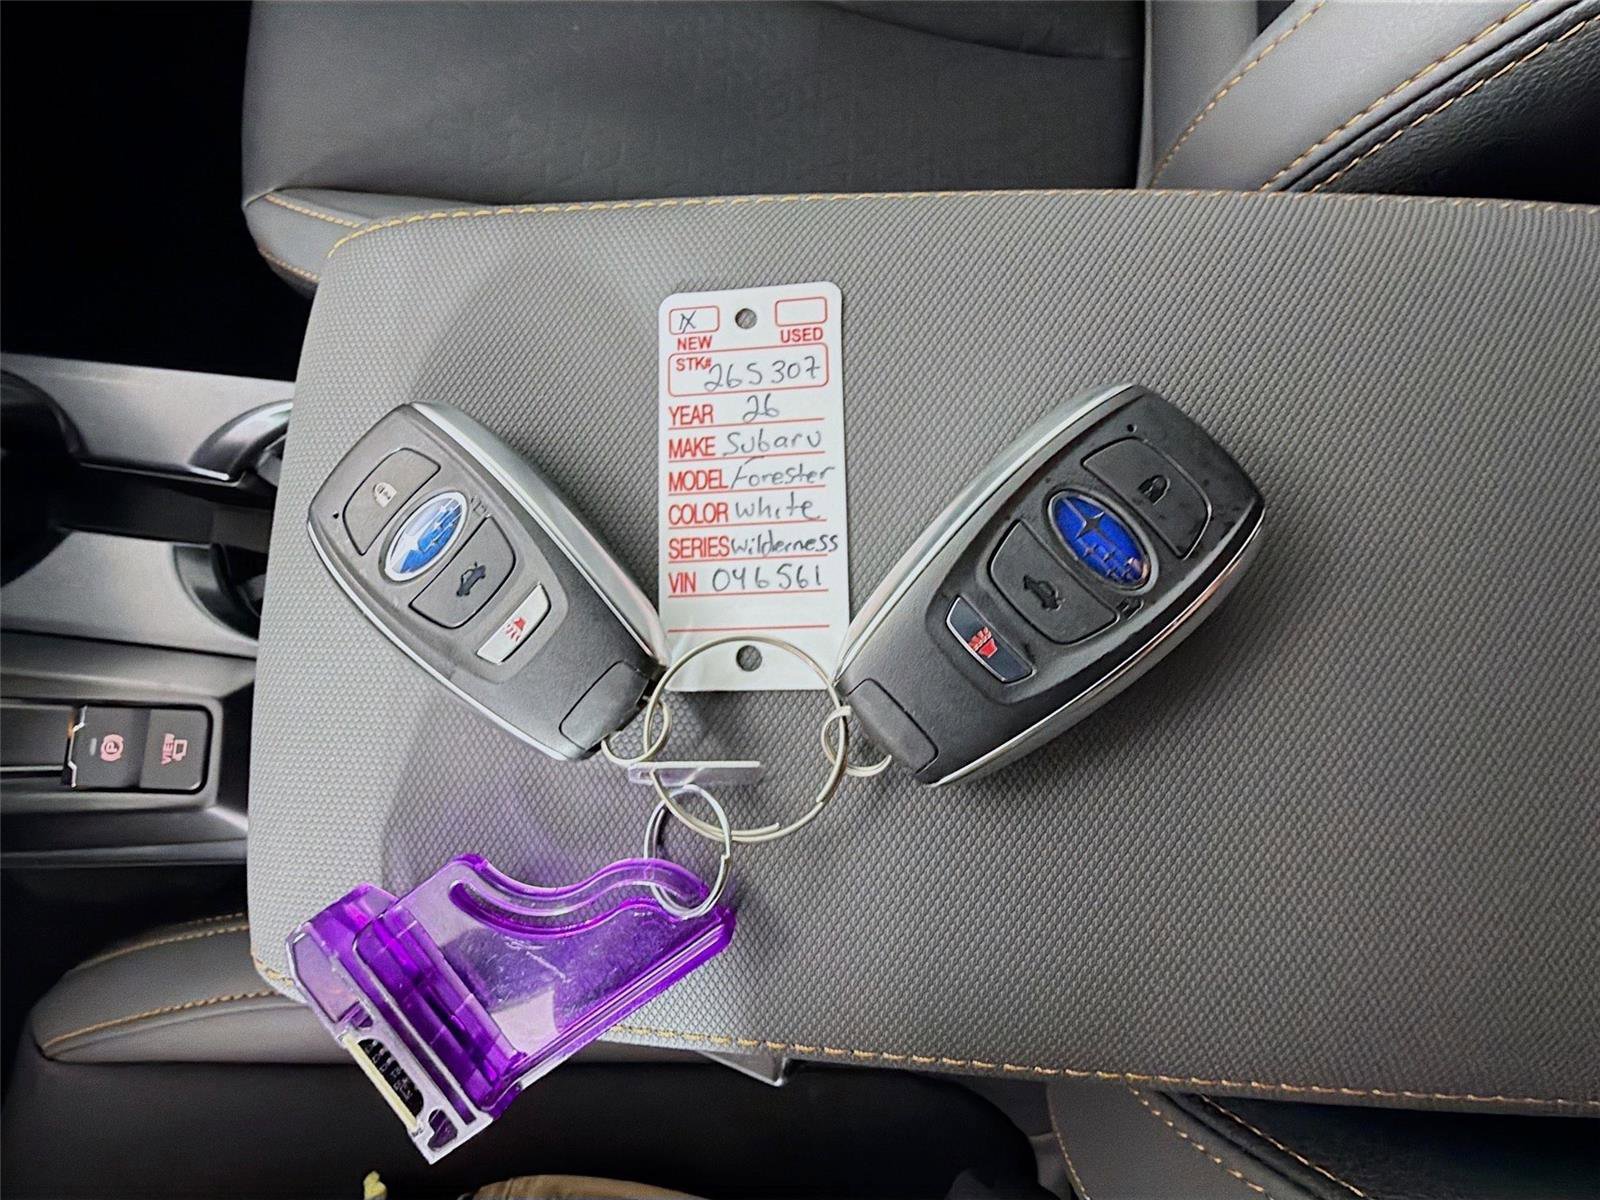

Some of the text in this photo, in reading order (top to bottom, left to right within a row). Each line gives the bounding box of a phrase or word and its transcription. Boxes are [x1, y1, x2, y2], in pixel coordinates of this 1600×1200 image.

[676, 335, 713, 351] NEW
[780, 327, 824, 344] USED
[675, 356, 712, 372] STK#
[668, 393, 780, 426] YEAR 26
[668, 428, 822, 459] MAKE Subaru
[668, 455, 836, 492] MODEL Forester
[668, 501, 729, 526] COLOR
[668, 535, 730, 560] SERIES
[668, 563, 823, 594] VIN 046561
